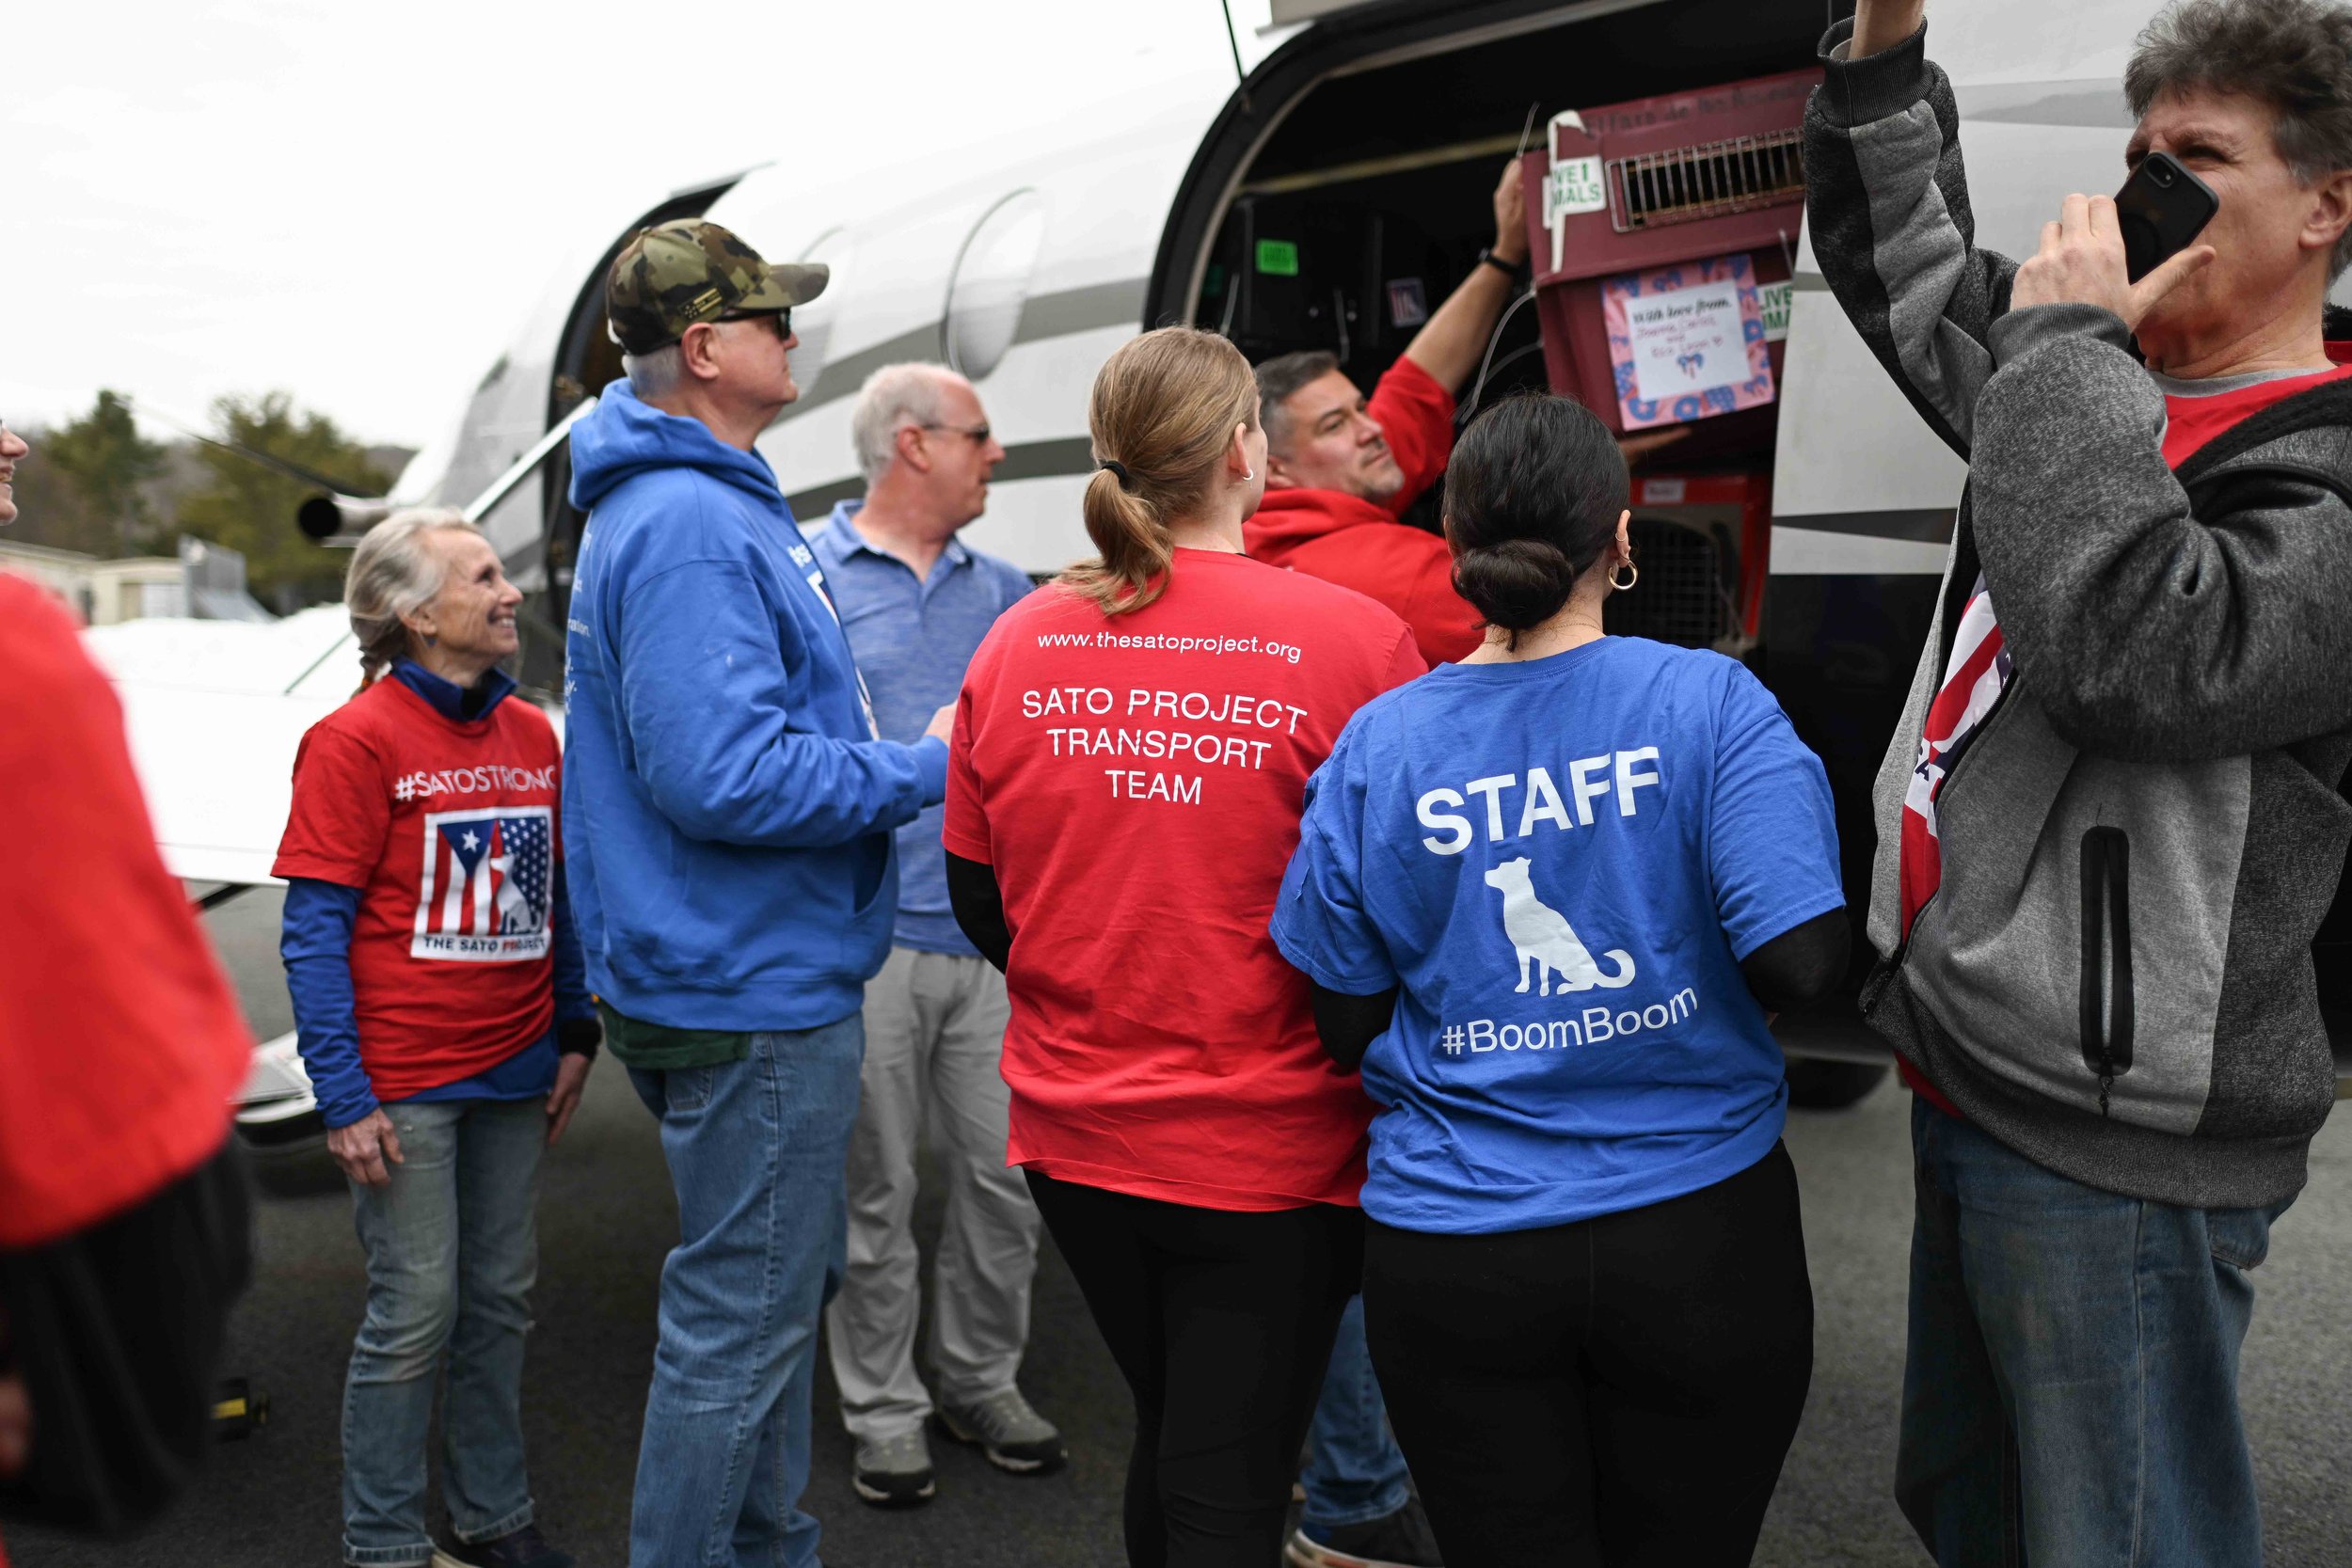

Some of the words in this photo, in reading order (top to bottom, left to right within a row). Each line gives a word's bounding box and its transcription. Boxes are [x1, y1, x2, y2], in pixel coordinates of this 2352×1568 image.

[1666, 303, 1694, 319] love
[1037, 631, 1302, 664] www.thesatoproject.org
[1022, 687, 1114, 719] SATO
[1127, 689, 1308, 735] PROJECT
[1046, 727, 1272, 769] TRANSPORT
[1104, 768, 1203, 805] TEAM
[1415, 746, 1661, 857] STAFF
[423, 936, 455, 950] THE
[459, 939, 499, 953] SATO
[1441, 986, 1700, 1055] #BoomBoom
